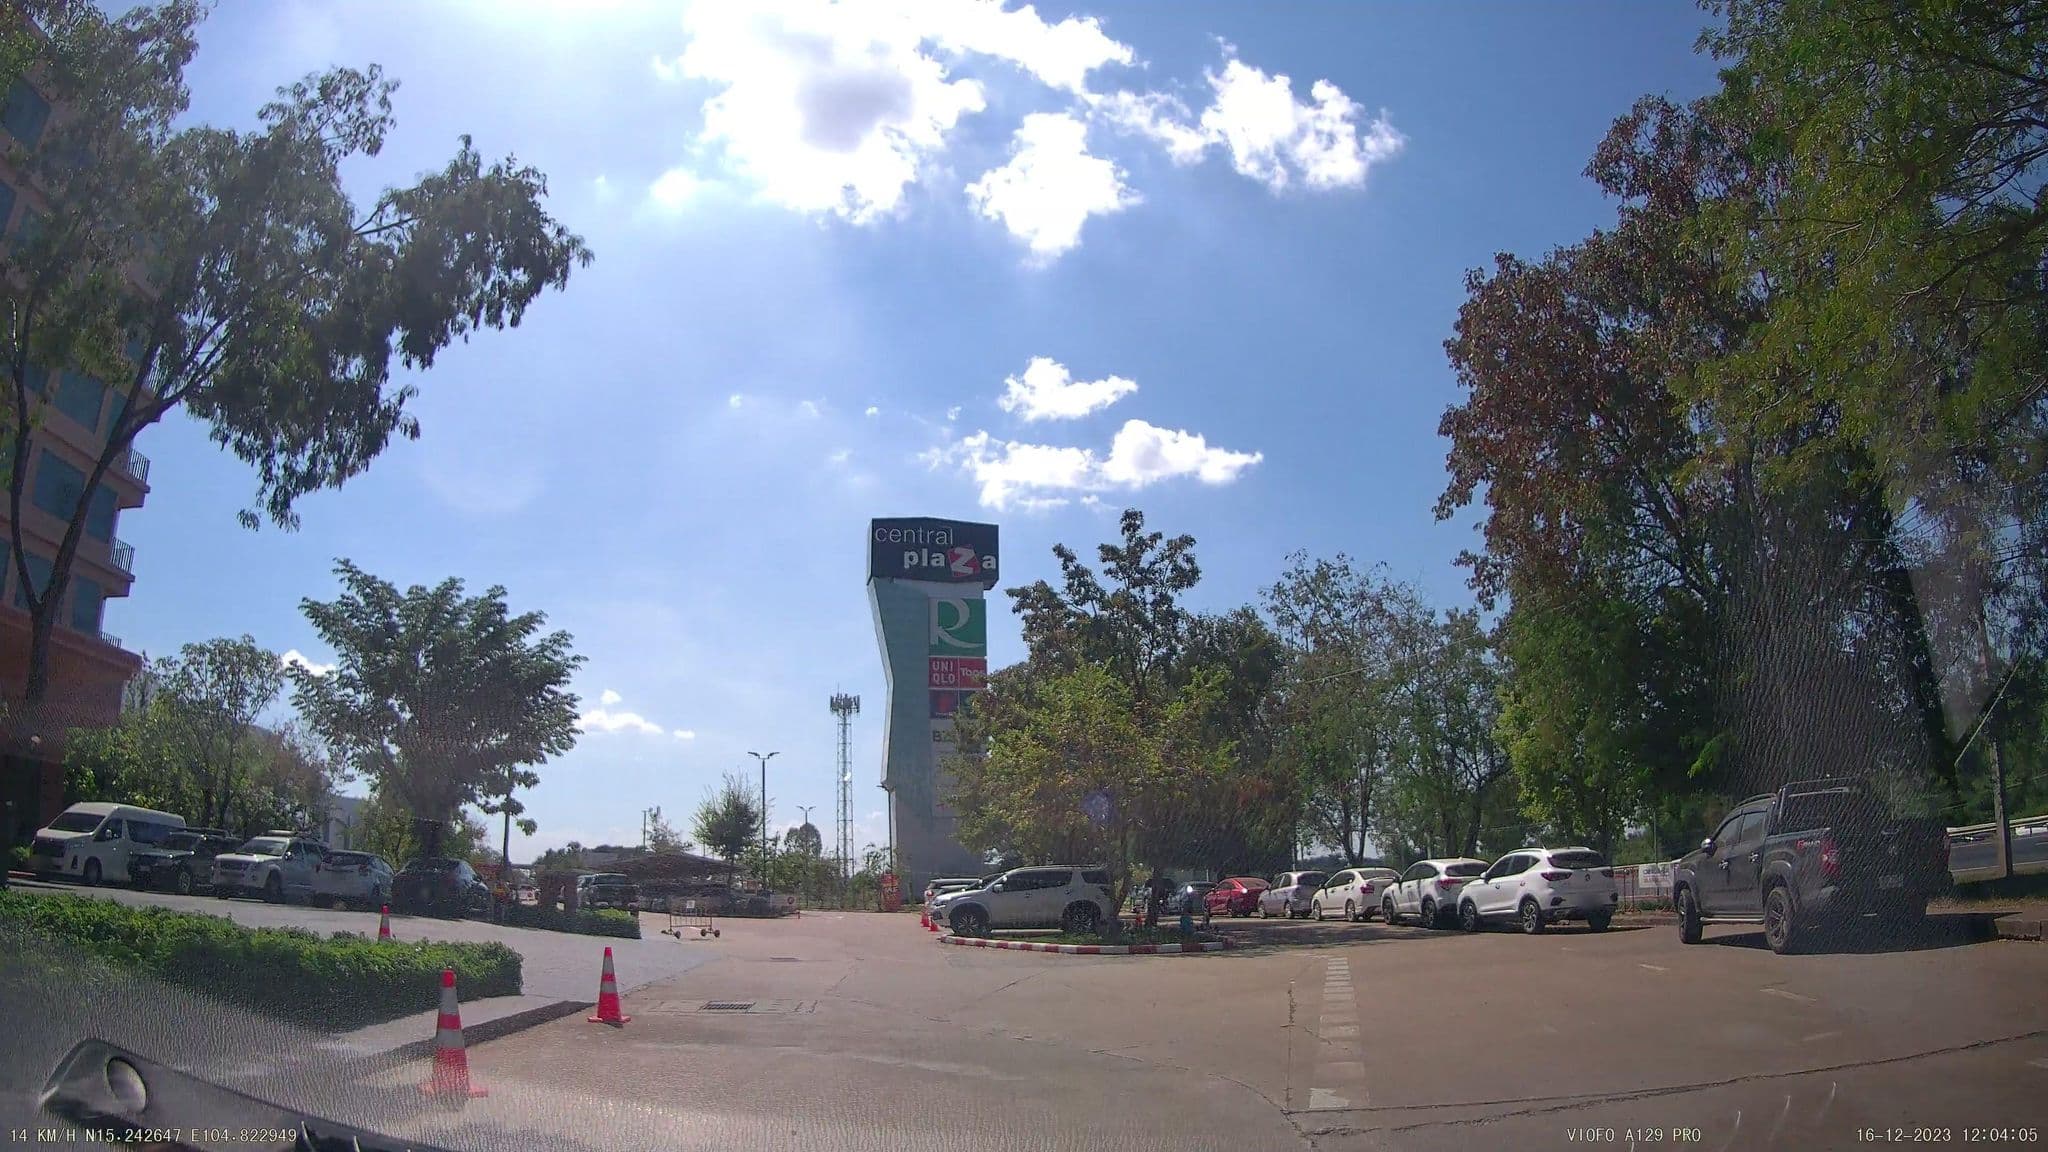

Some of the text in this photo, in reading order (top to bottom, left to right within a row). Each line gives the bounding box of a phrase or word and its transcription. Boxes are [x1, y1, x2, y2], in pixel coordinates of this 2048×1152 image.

[875, 525, 953, 545] central
[932, 660, 954, 672] UNI
[932, 673, 956, 686] QLO
